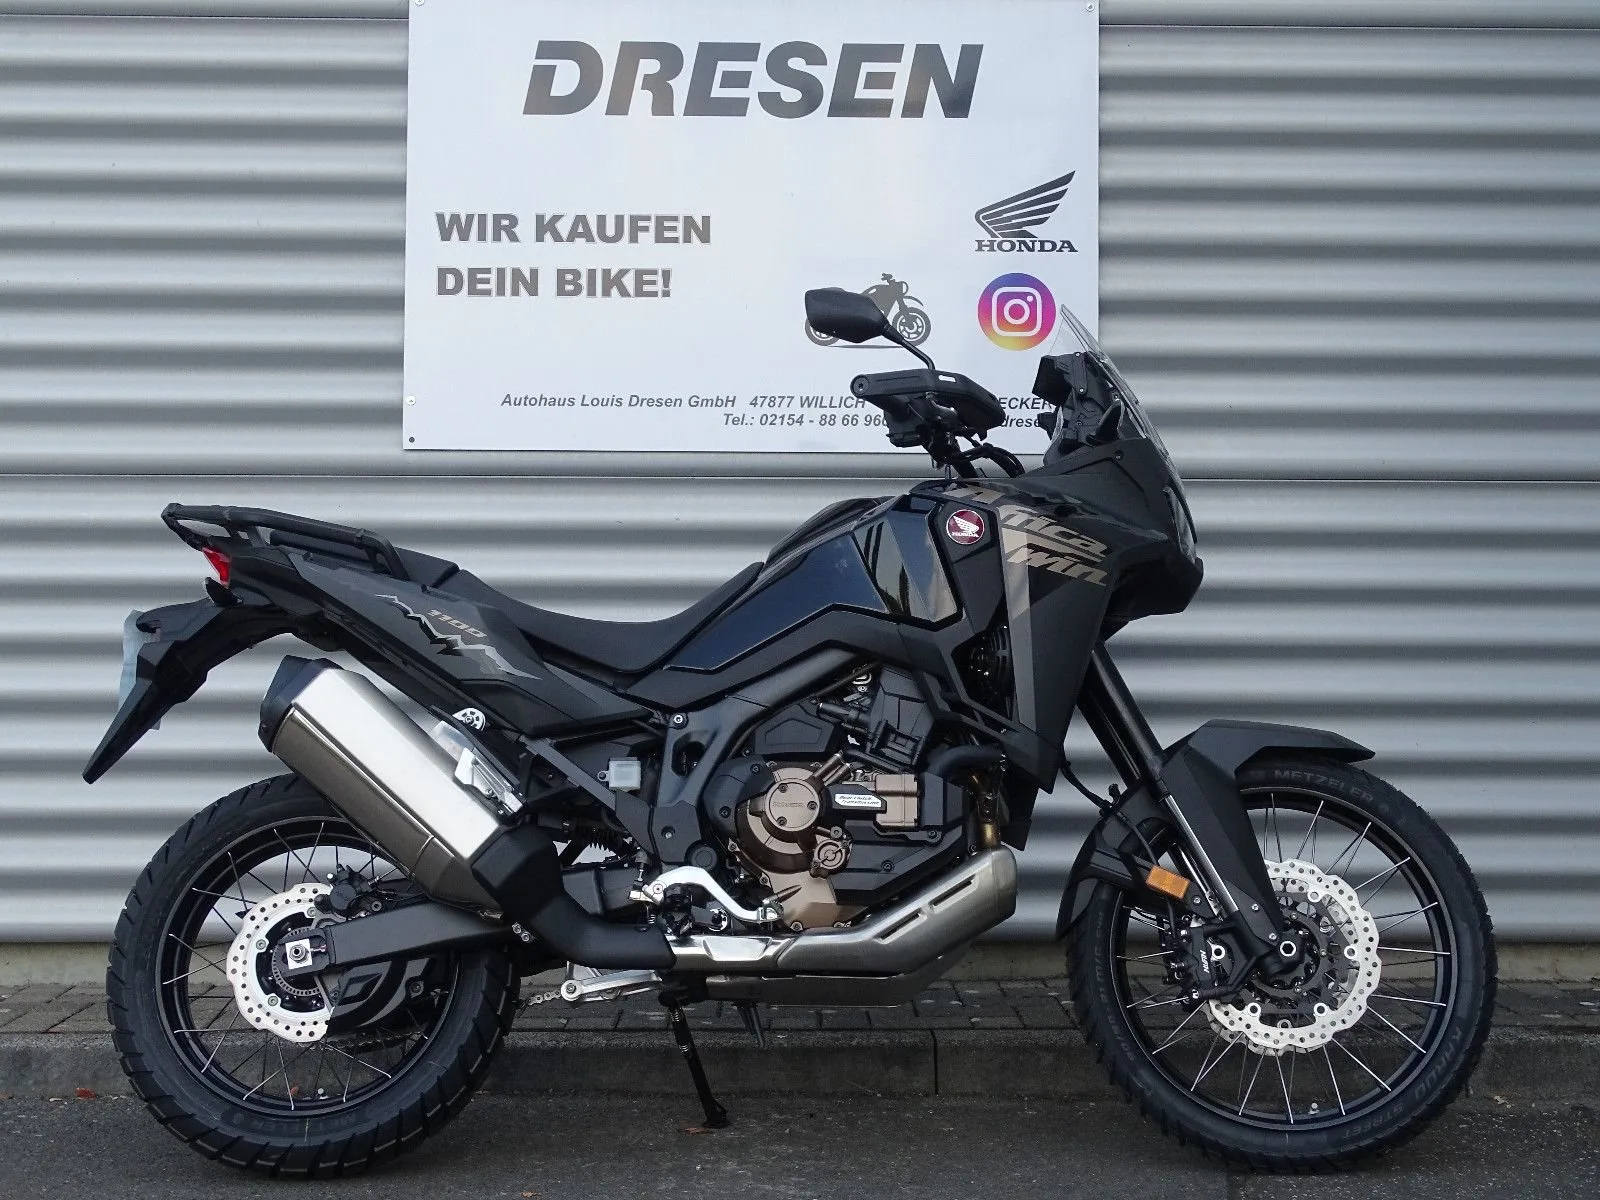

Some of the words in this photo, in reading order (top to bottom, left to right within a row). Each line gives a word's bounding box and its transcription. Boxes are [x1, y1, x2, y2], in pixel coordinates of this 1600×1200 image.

[522, 40, 984, 119] DRESEN
[435, 212, 521, 243] WIR
[535, 213, 711, 244] KAUFEN
[974, 239, 1079, 253] HONDA
[437, 267, 538, 297] DEIN
[556, 268, 671, 299] BIKE!
[501, 394, 576, 407] Autohaus
[580, 395, 623, 408] Louis
[628, 395, 683, 408] Dresen
[687, 395, 737, 408] GmbH
[749, 396, 795, 408] 47877
[799, 396, 866, 409] WILLICH
[723, 413, 755, 426] Tel.:
[759, 414, 805, 427] 02154
[819, 414, 837, 427] 88
[841, 414, 860, 427] 66
